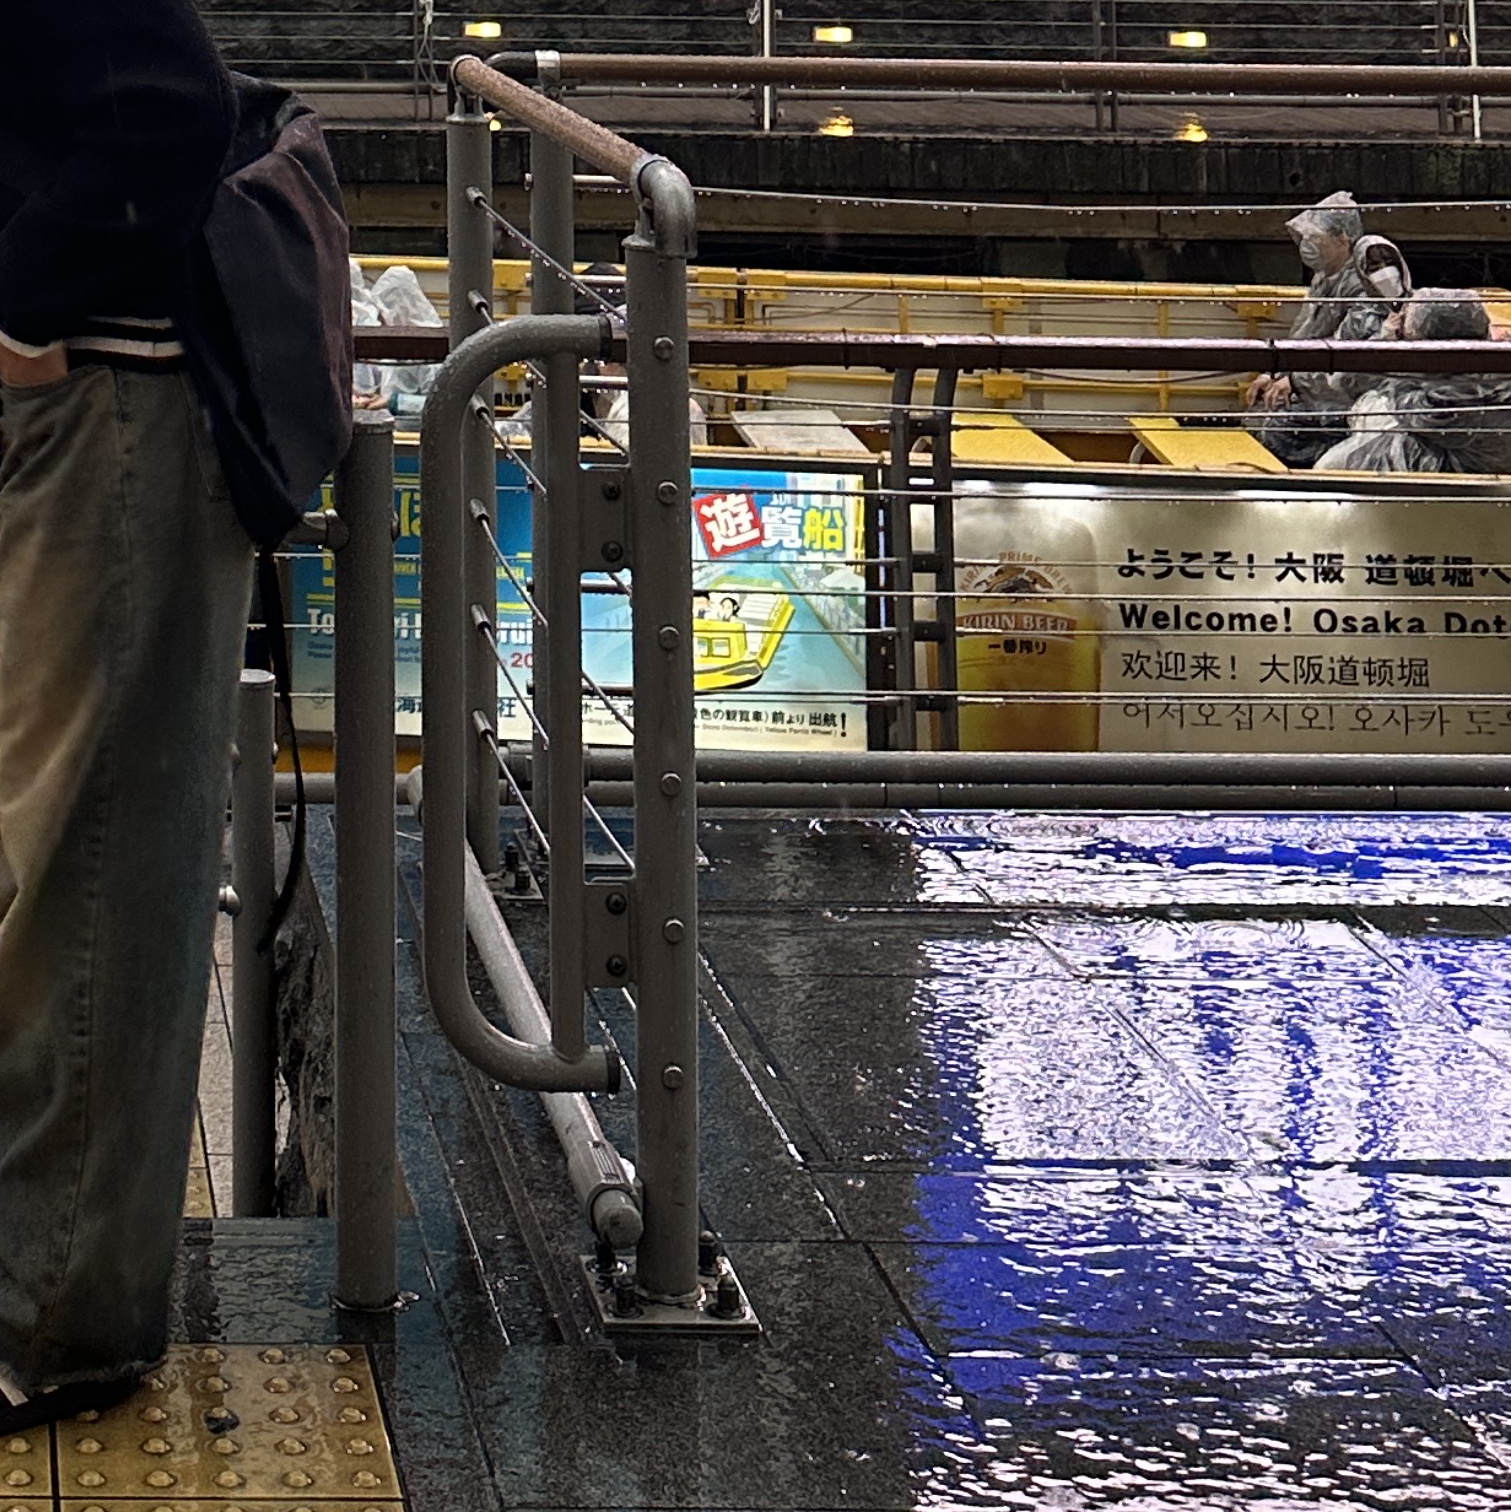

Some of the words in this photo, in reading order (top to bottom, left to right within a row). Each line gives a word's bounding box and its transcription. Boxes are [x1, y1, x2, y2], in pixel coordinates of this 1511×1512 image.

[699, 492, 844, 554] 遊覧船
[1117, 548, 1256, 580] ようこそ!
[1274, 552, 1346, 584] 大阪
[1118, 602, 1293, 634] Welcome!
[1313, 608, 1426, 634] Osaka
[1121, 650, 1238, 682] 欢迎来!
[1259, 654, 1431, 689] 大阪道顿堀
[1349, 704, 1451, 737] 오사카
